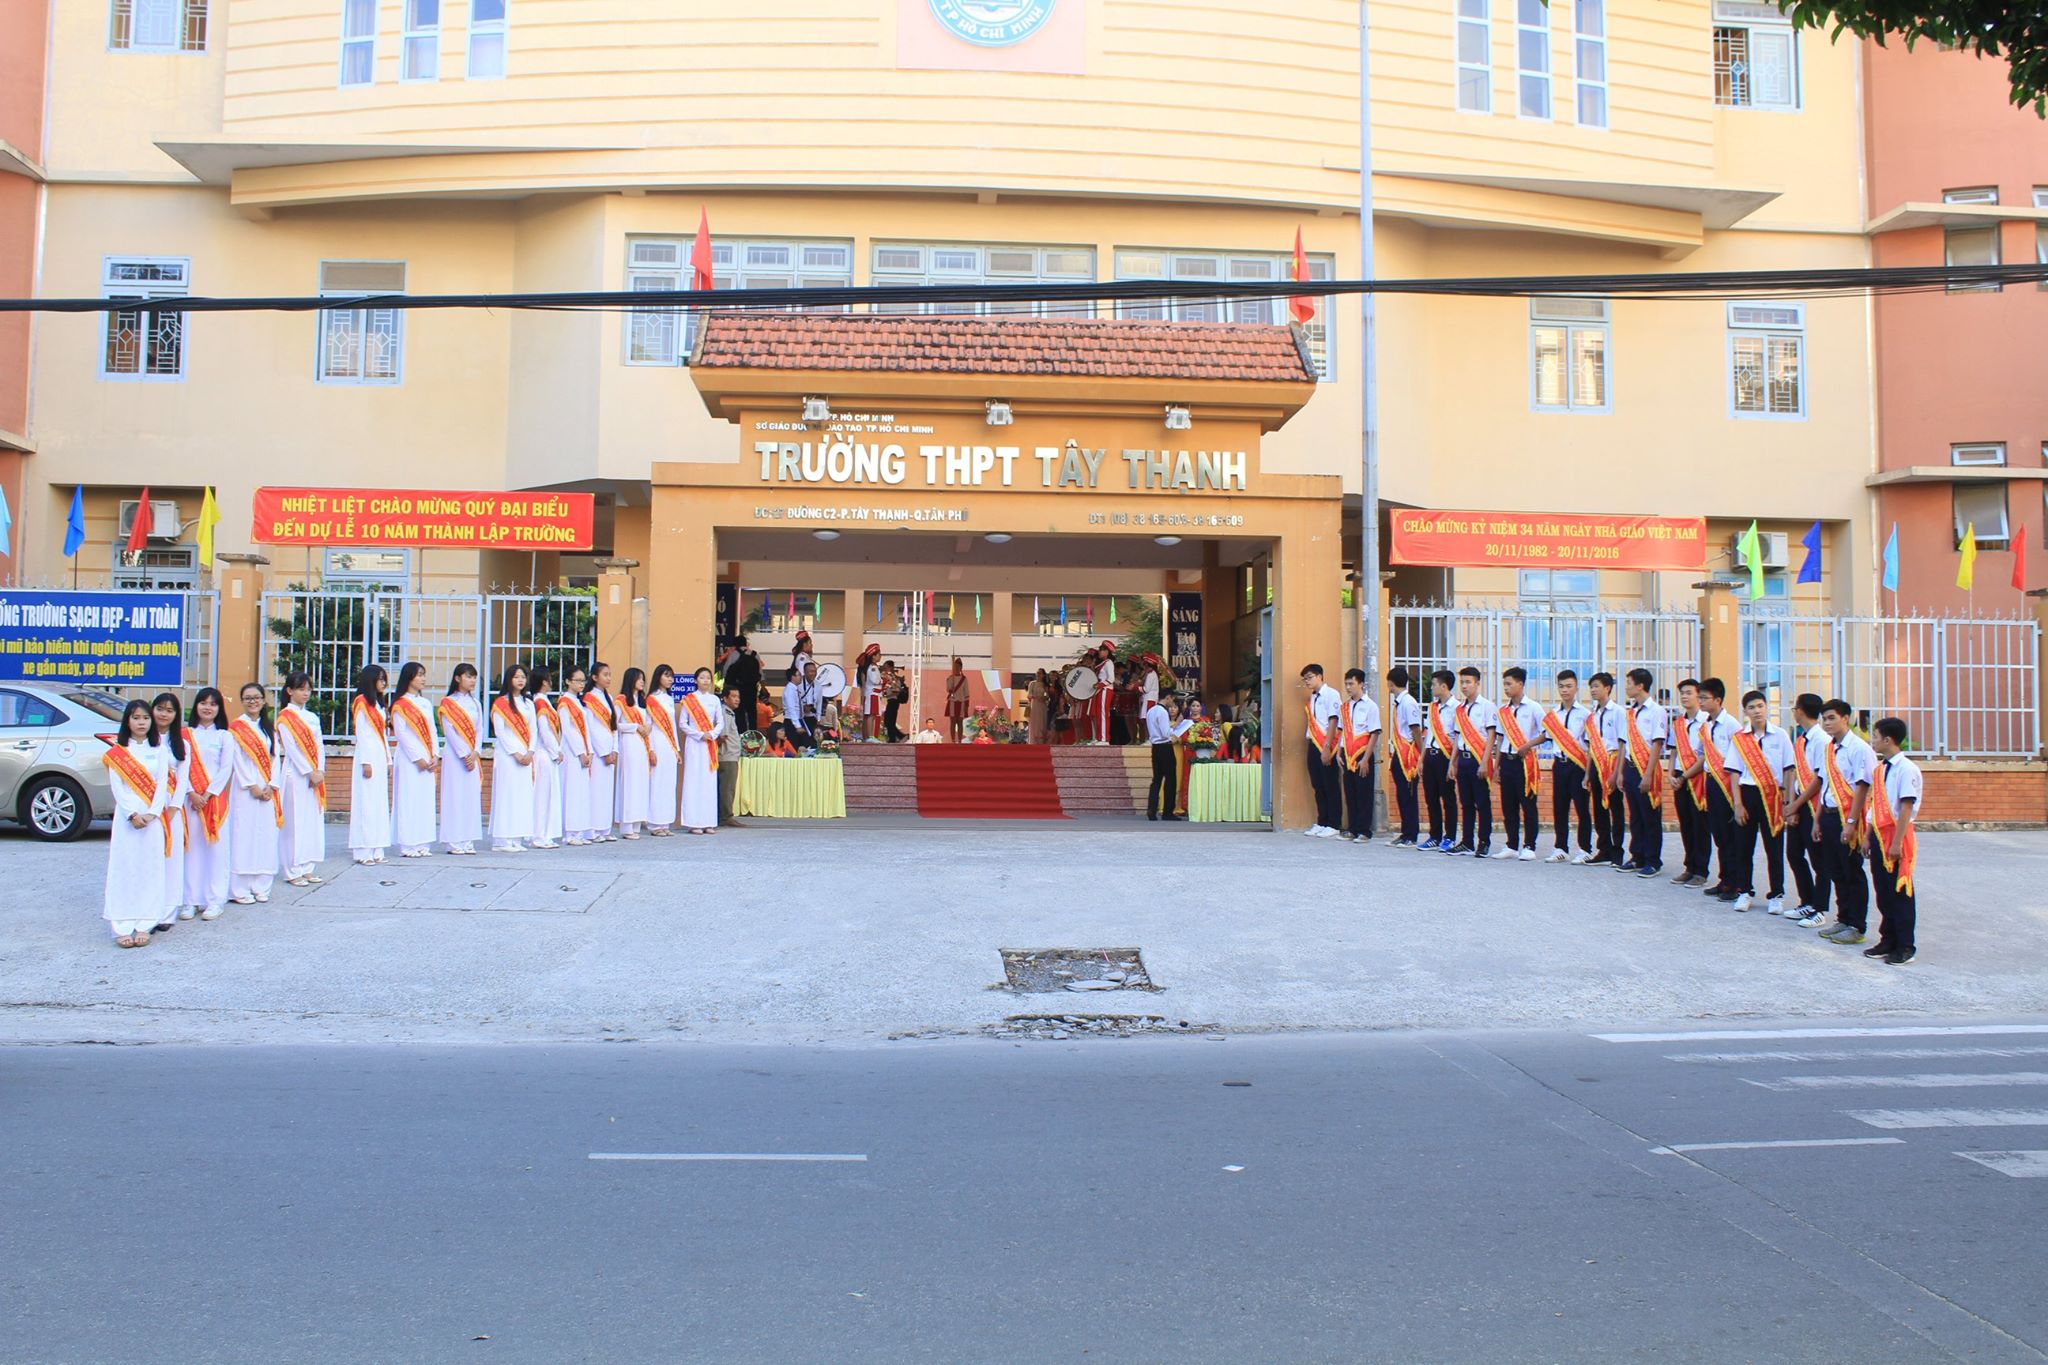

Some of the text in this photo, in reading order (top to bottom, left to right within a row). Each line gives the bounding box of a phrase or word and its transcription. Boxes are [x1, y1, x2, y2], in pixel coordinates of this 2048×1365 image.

[1010, 6, 1044, 35] MINH
[912, 426, 934, 434] MINH
[755, 433, 1247, 495] TRƯỜNG THPT TÂY THẠNH
[281, 496, 569, 518] NHIỆT LIỆT CHÀO MỪNG QUÝ ĐẠI BIỂU
[272, 514, 575, 544] ĐẾN DỰ LỄ 10 NĂM THÀNH LẬP TRƯỜNG
[1403, 519, 1698, 541] CHÀO MỪNG KỶ NIỆM 34 NĂM NGÀY NHÀ GIÁO VIỆT NAM
[1486, 544, 1548, 558] 20/11/1982
[1558, 544, 1620, 560] 20/11/2016
[22, 601, 68, 628] TRƯỜNG
[69, 606, 100, 633] SẠCH
[102, 607, 124, 634] ĐẸP
[132, 607, 148, 629] AN
[150, 603, 179, 630] TOÀN
[1172, 606, 1199, 623] SÁNG
[7, 639, 23, 654] mũ
[25, 637, 44, 654] bảo
[46, 637, 72, 654] hiểm
[74, 640, 90, 655] khi
[92, 639, 114, 657] ngồi
[116, 640, 136, 656] trên
[138, 643, 150, 656] xe
[23, 658, 144, 680] xe gắn máy, xe đạp điện!
